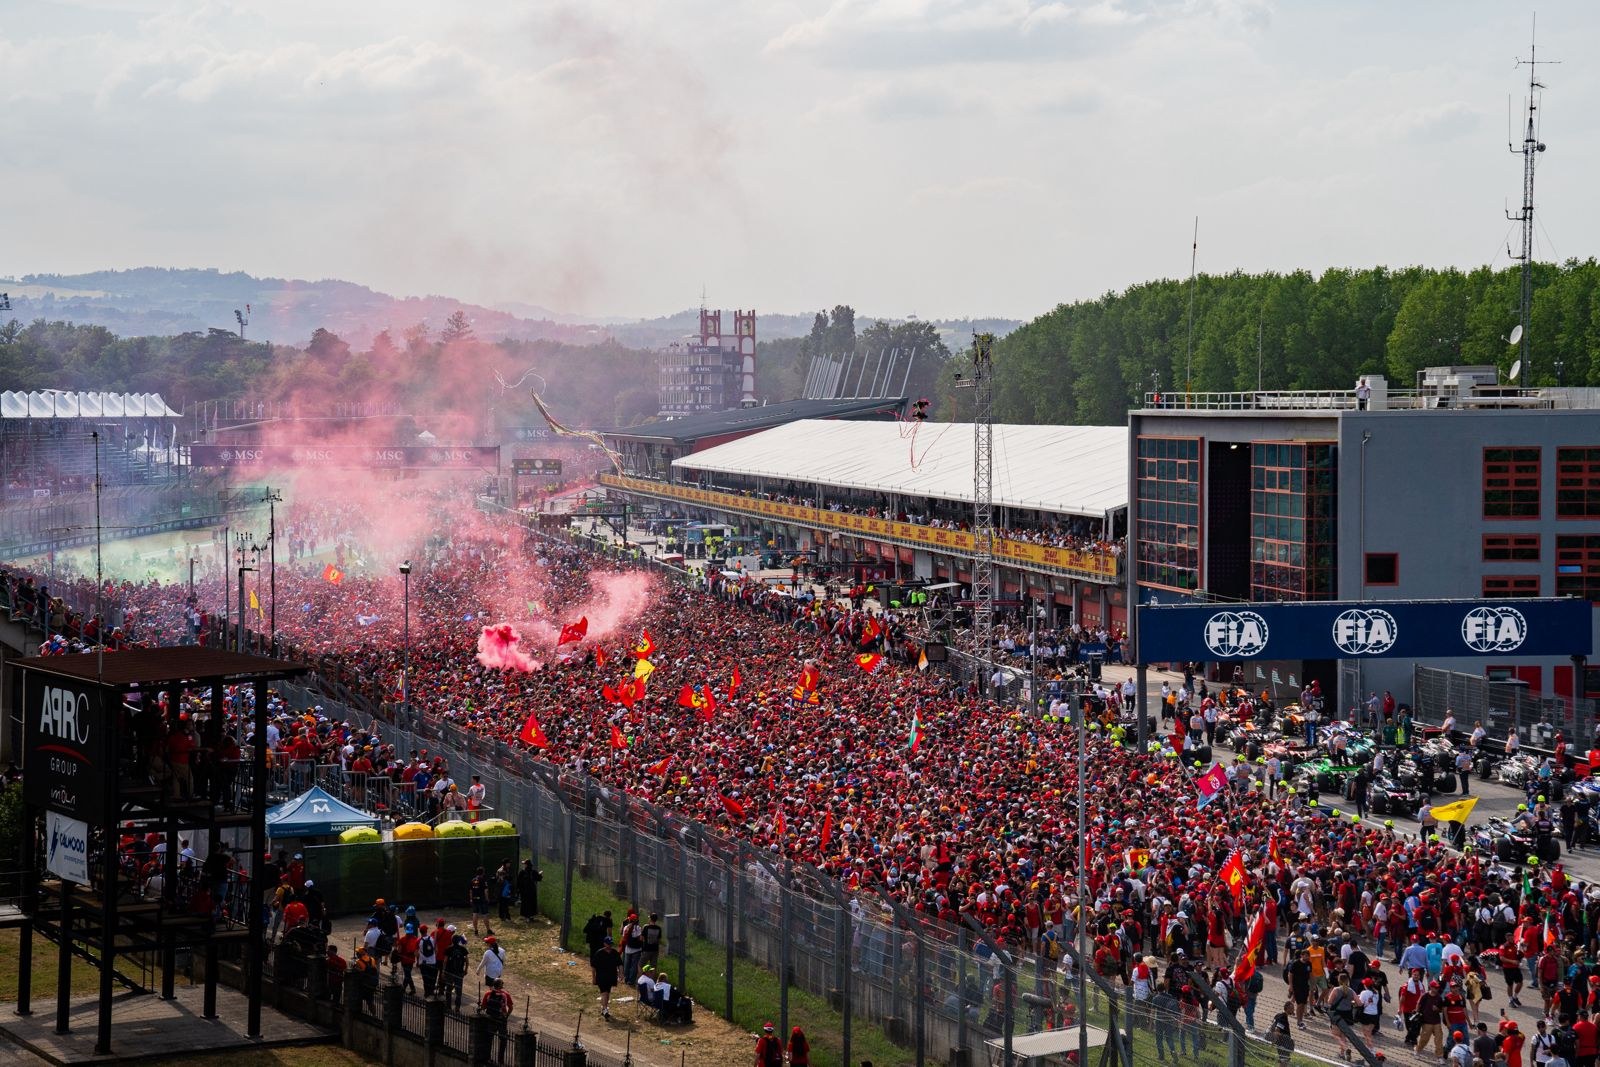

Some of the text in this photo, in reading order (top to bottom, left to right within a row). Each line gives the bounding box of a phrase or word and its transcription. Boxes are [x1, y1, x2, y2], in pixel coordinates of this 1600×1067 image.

[527, 429, 549, 438] MSC
[235, 450, 263, 460] MSC
[306, 450, 334, 460] MSC
[375, 450, 403, 460] MSC
[445, 450, 472, 460] MSC
[50, 757, 77, 777] GROUP
